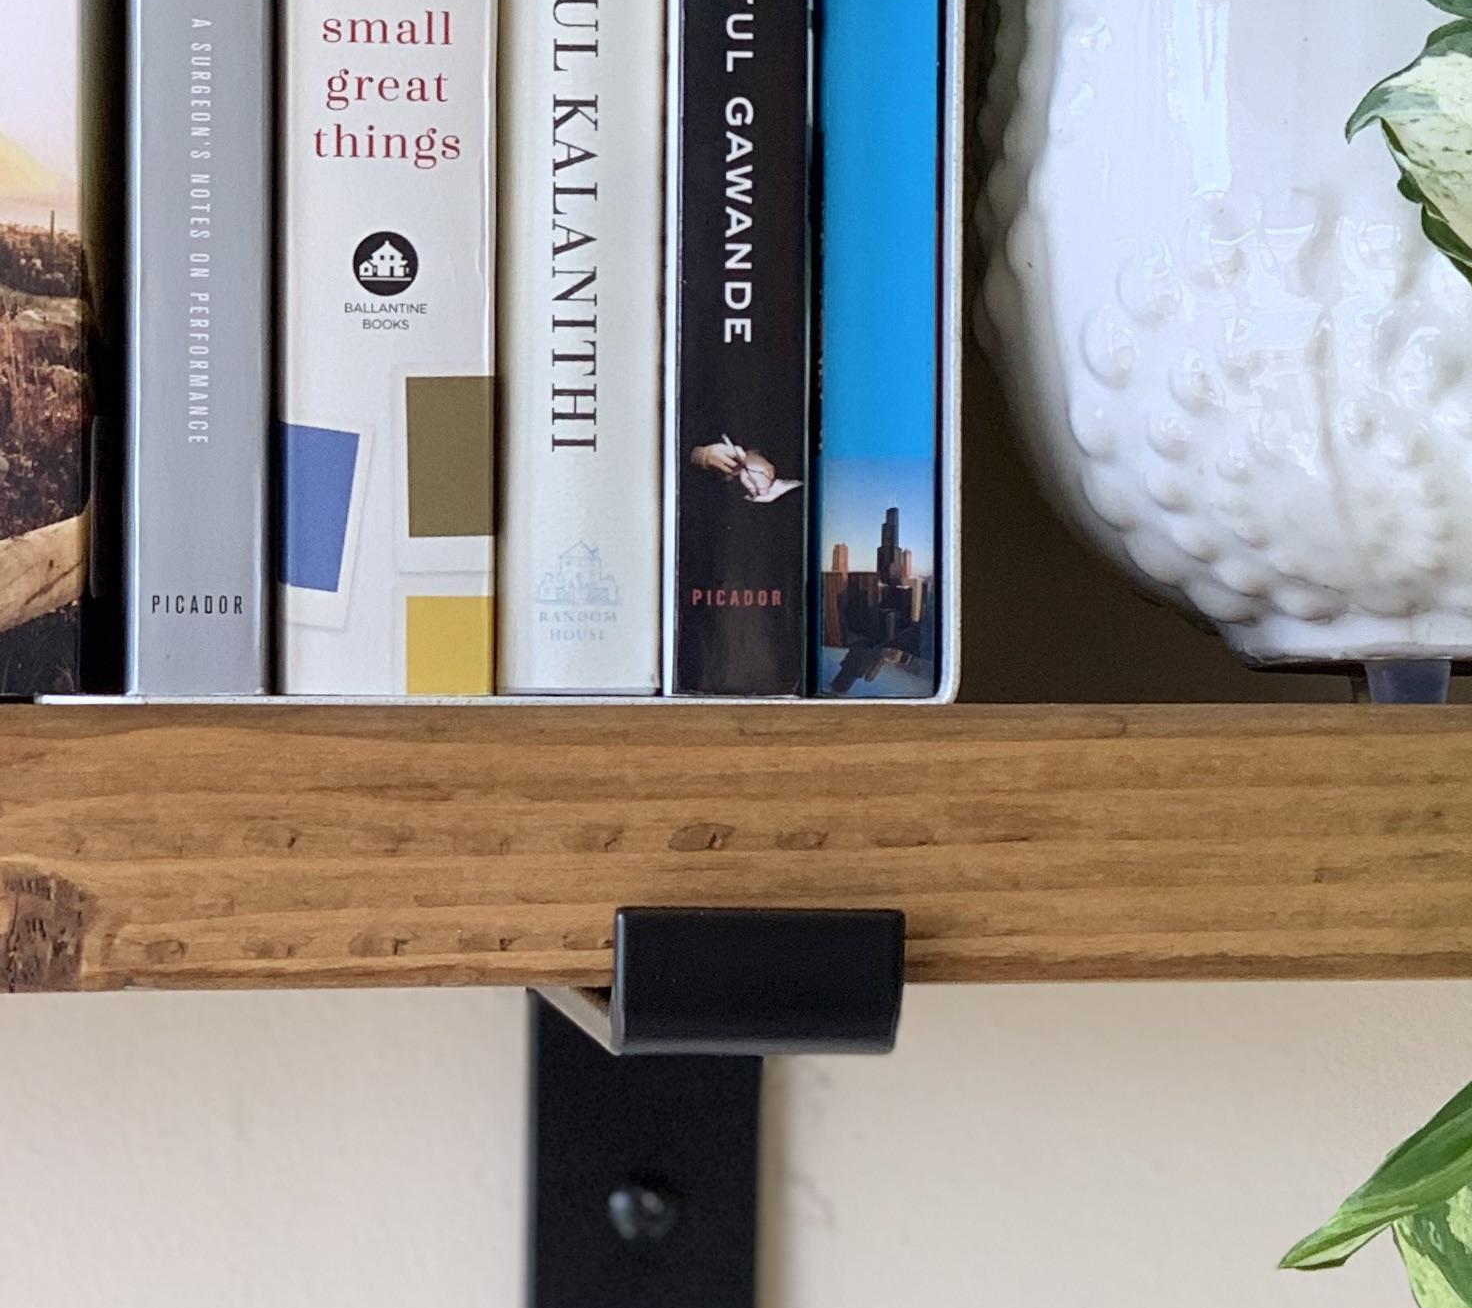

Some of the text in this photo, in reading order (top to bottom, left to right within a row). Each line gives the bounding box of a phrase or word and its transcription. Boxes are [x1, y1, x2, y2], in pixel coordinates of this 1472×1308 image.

[322, 10, 453, 46] small
[326, 68, 449, 111] great
[313, 123, 461, 169] things
[187, 18, 212, 445] A SURGEON'S NOTES ON PERFORMANCE
[723, 95, 755, 345] GAWANDE
[551, 93, 600, 454] KALANITHI
[344, 302, 428, 315] BALLANTINE
[362, 318, 410, 331] BOOKS
[151, 594, 243, 615] PICADOR
[690, 588, 782, 607] PICADOR
[538, 610, 618, 624] RANDOM
[550, 628, 606, 641] HOUSE
